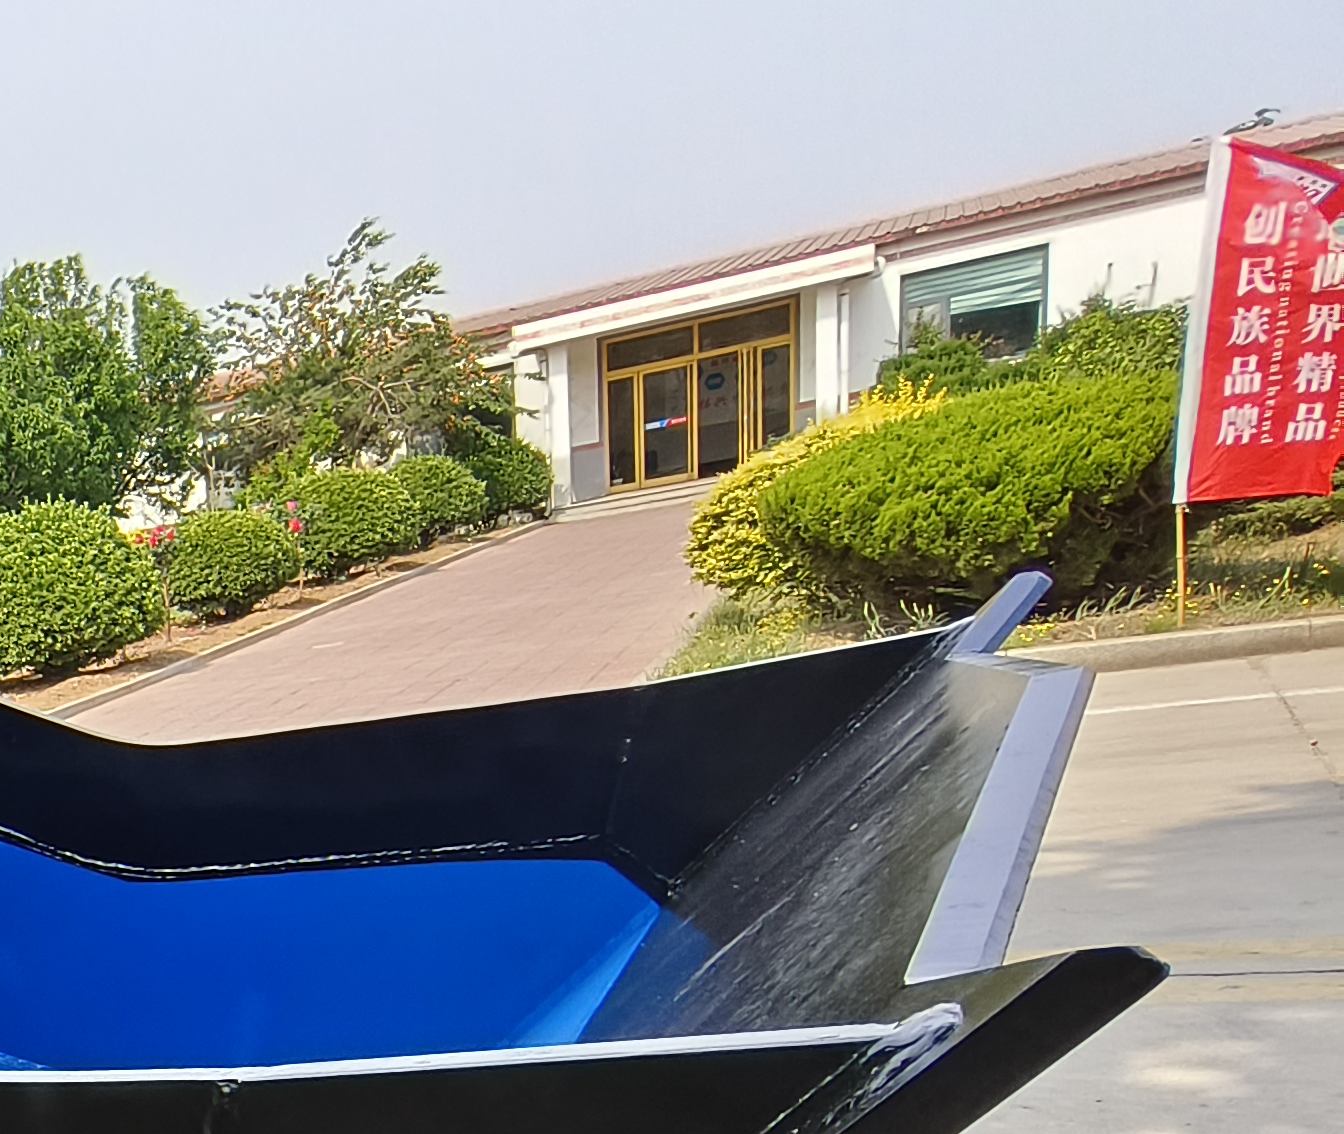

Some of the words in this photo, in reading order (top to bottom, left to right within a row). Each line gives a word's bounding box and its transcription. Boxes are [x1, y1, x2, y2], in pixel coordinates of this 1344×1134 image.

[1216, 201, 1288, 446] 创民族品牌
[1261, 386, 1282, 444] brand
[1285, 216, 1344, 443] 世界精品
